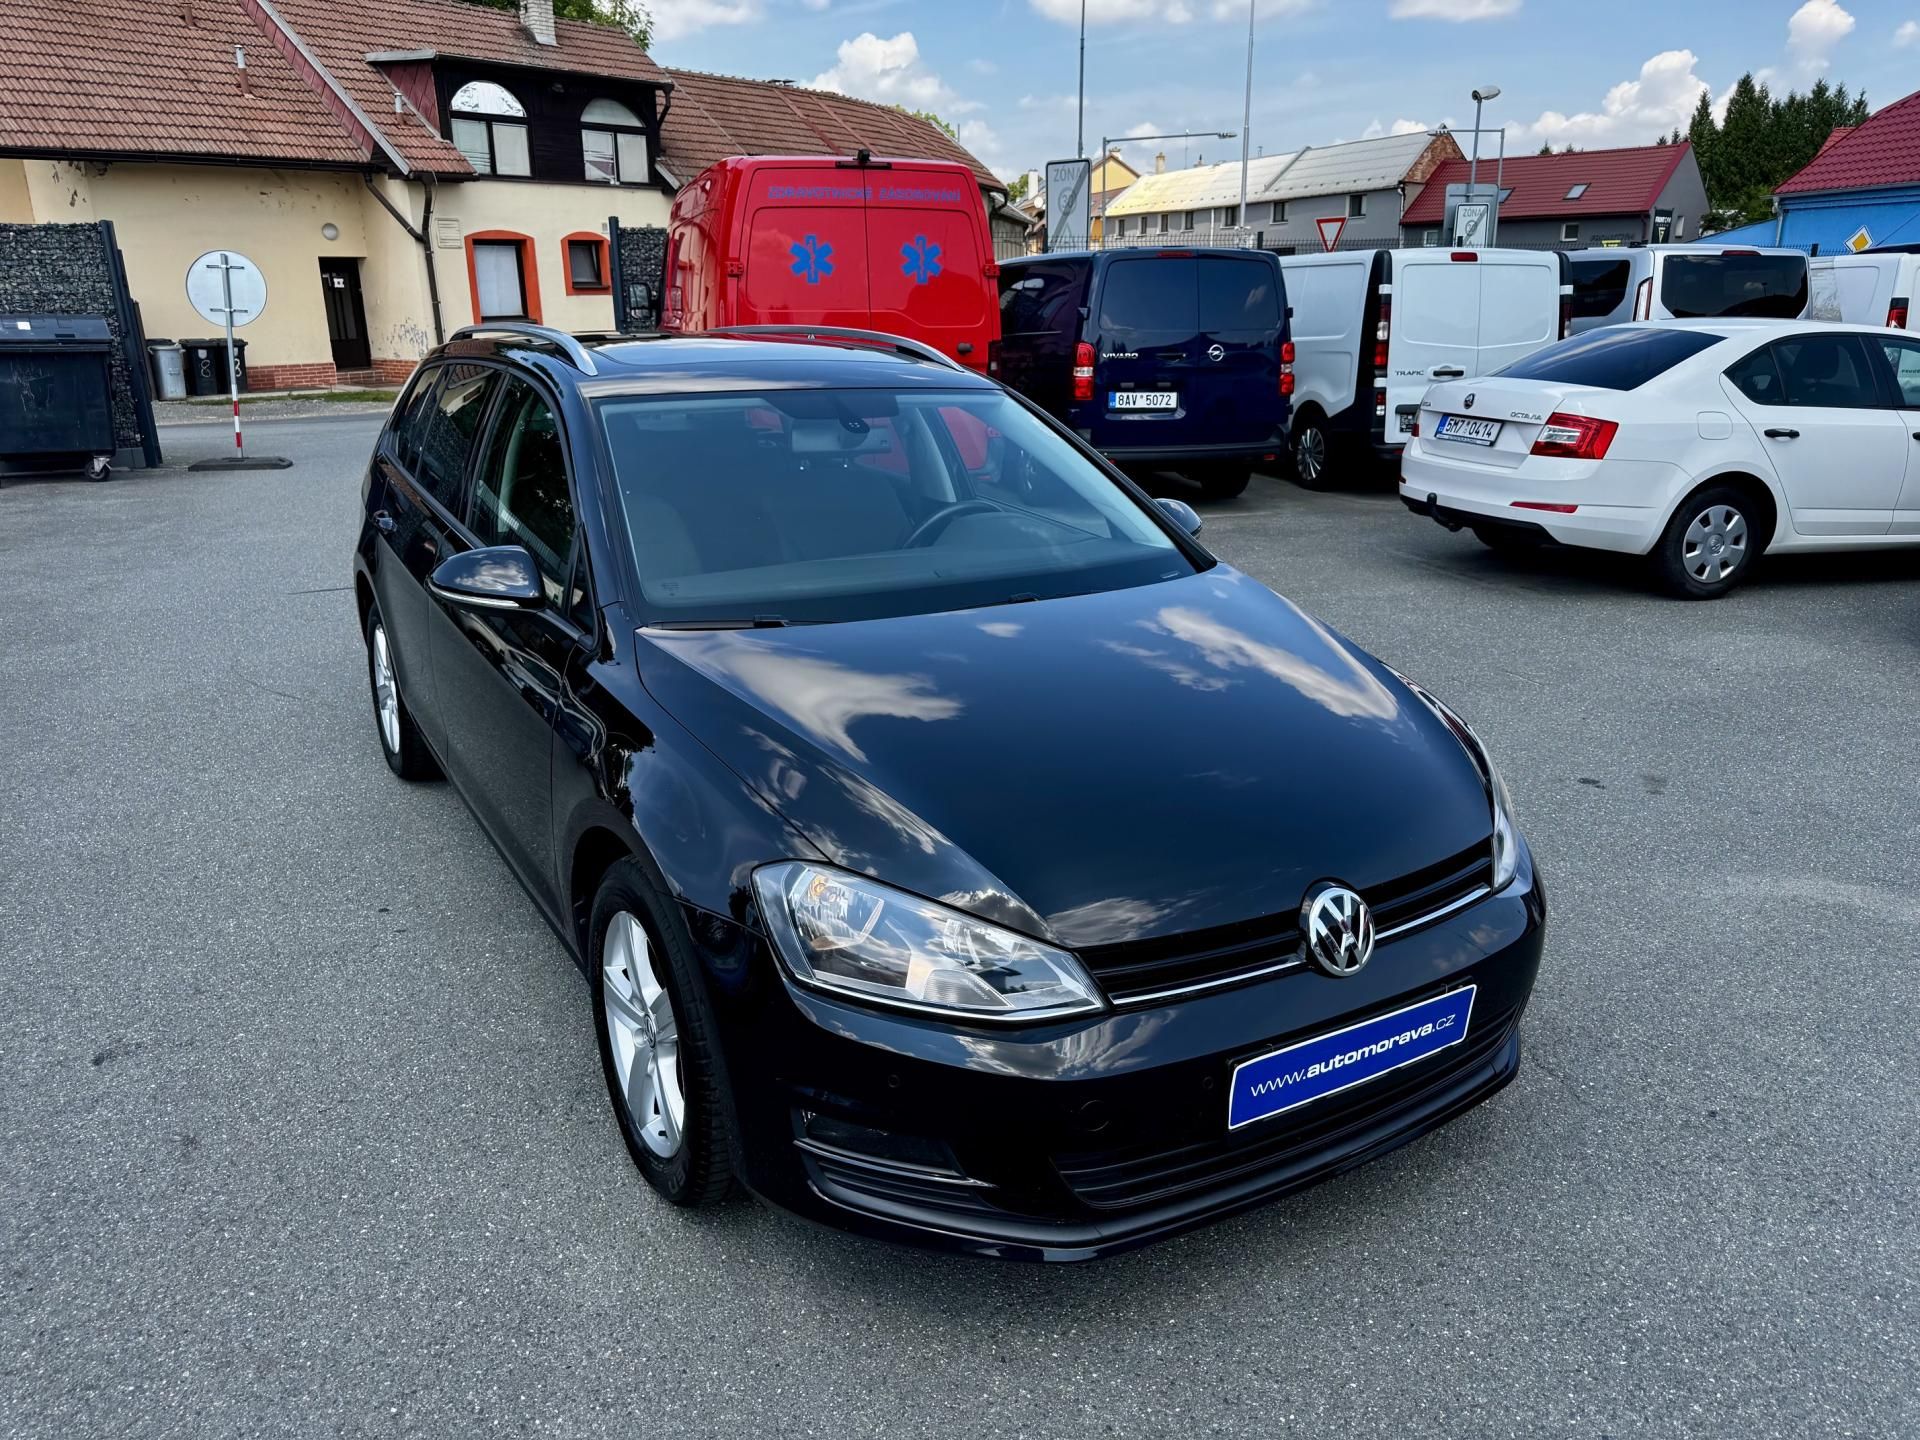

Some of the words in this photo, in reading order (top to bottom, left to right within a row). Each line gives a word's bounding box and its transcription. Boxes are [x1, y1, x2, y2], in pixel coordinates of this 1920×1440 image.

[1118, 394, 1138, 406] 8AV
[1145, 394, 1171, 406] 5072
[1445, 418, 1466, 434] 5M7
[1468, 422, 1495, 438] 0414
[1250, 1013, 1456, 1097] www.automorava.cz
